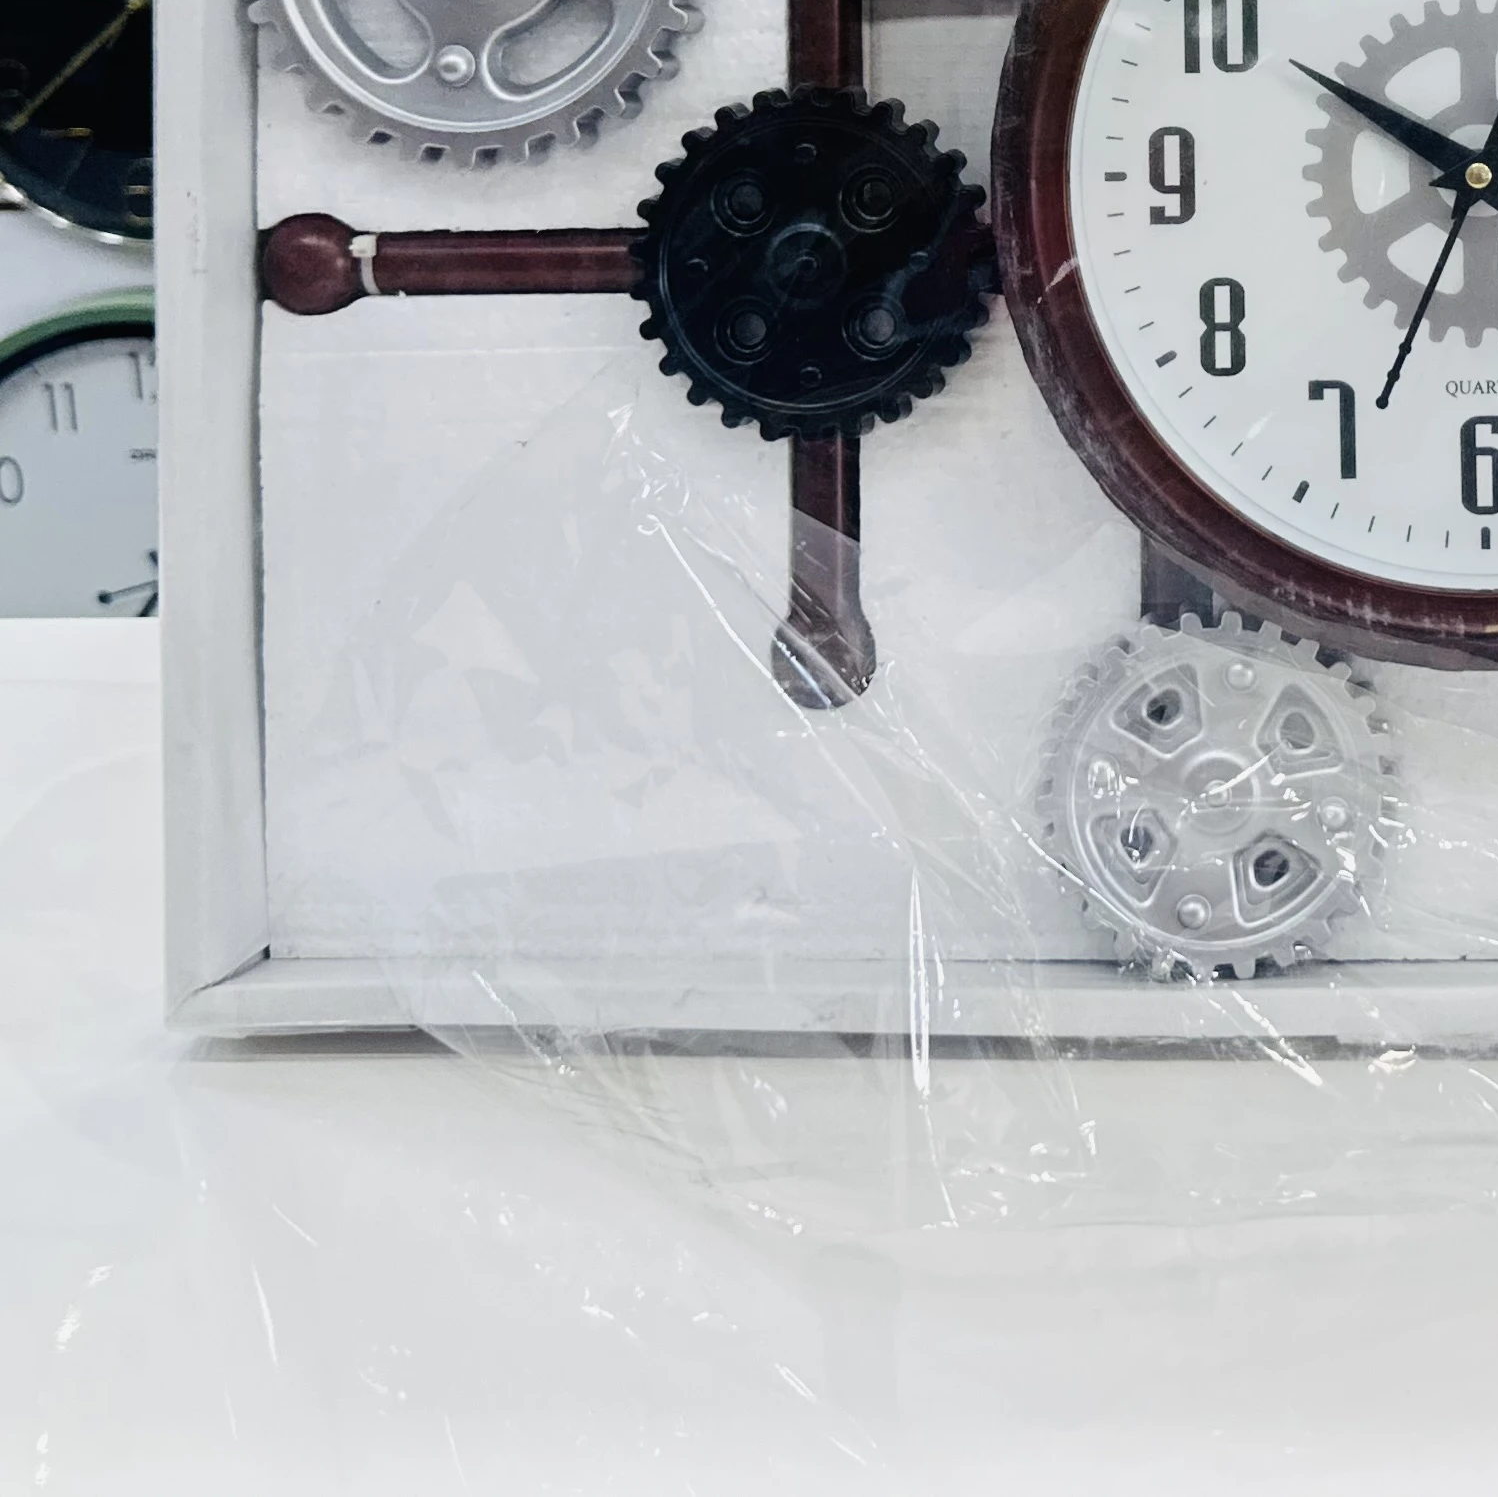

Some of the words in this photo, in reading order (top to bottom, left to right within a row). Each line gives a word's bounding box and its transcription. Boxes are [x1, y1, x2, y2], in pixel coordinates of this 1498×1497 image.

[1148, 126, 1196, 225] 9
[1199, 277, 1246, 376] 8
[42, 382, 77, 433] 11
[1308, 380, 1356, 479] 7
[0, 455, 24, 505] 0
